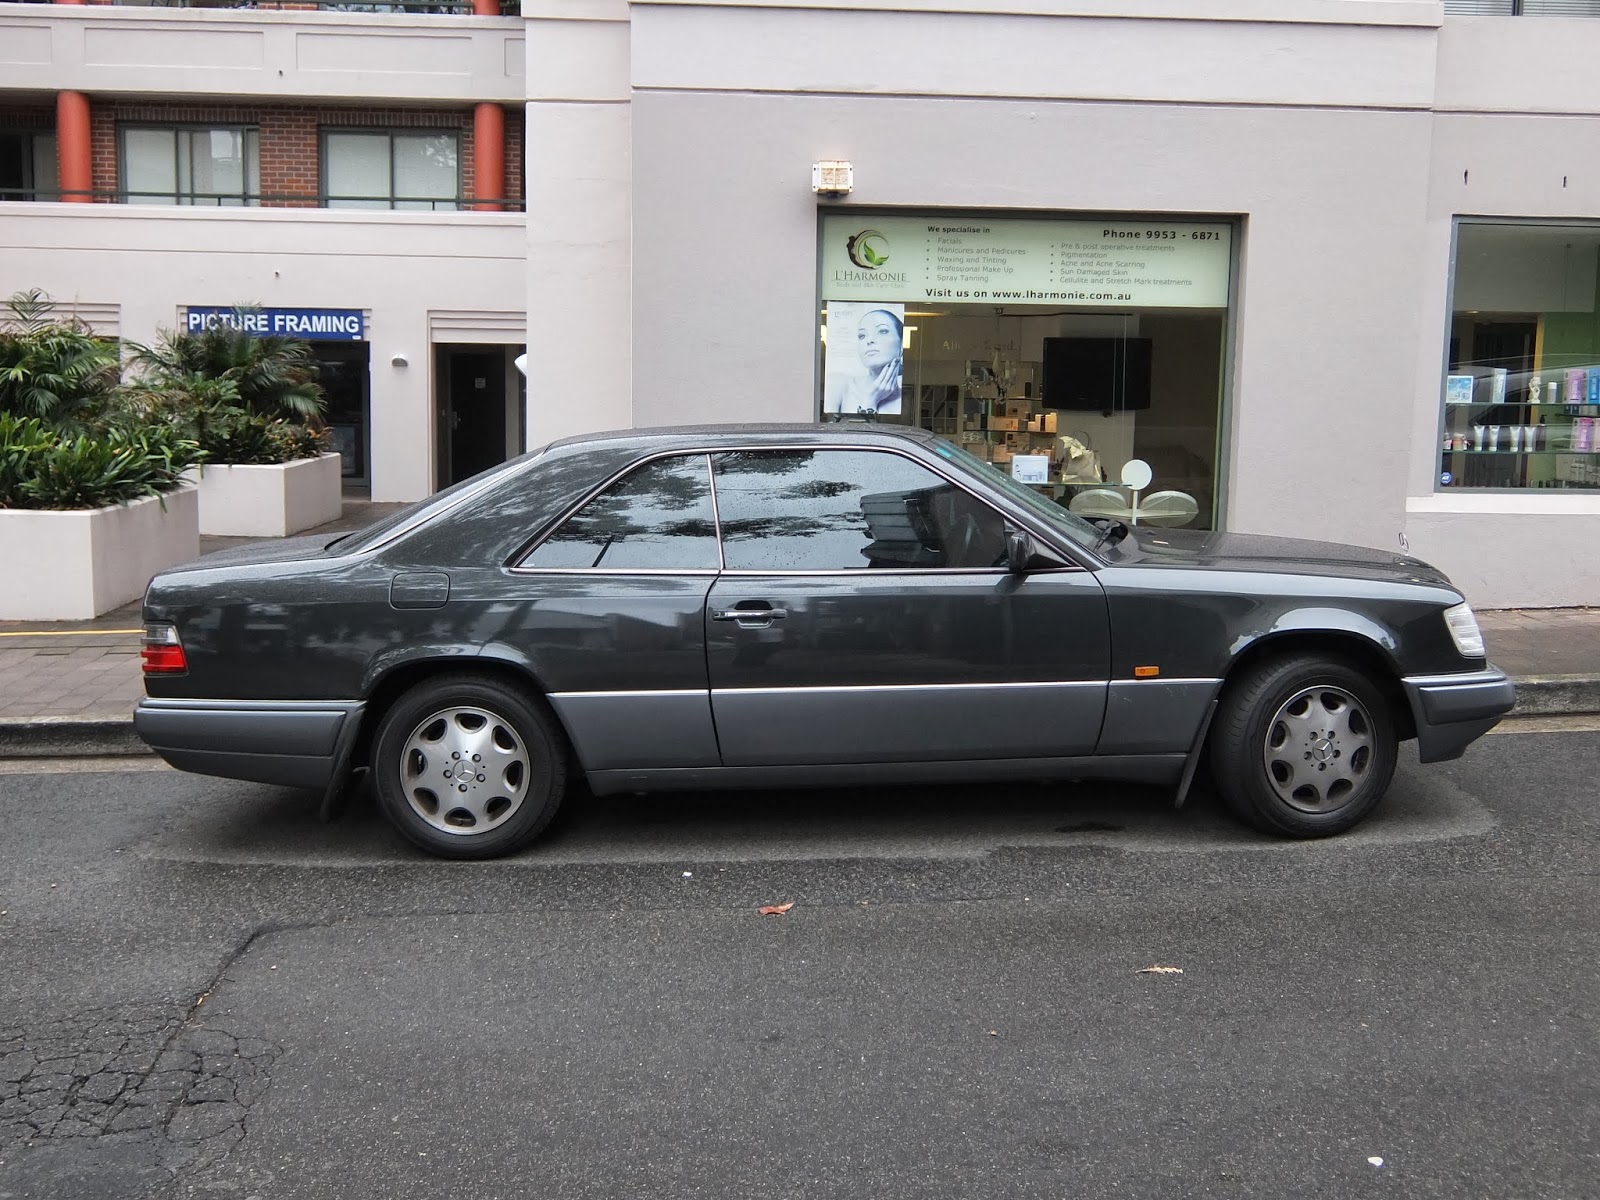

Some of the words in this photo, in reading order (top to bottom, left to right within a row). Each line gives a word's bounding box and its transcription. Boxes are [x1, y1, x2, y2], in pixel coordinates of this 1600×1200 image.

[942, 226, 981, 234] specialise
[1103, 230, 1141, 238] Phone
[1146, 231, 1176, 239] 9953
[1191, 231, 1220, 240] 6871
[1135, 244, 1176, 252] treatments
[1060, 251, 1108, 260] Pigmentation
[937, 256, 964, 264] Waxing
[1115, 261, 1145, 269] Scarring
[1076, 269, 1110, 277] Damaged
[937, 275, 958, 283] Spray
[960, 275, 989, 283] Tanning
[1153, 278, 1192, 286] treatments
[925, 289, 952, 297] Visit
[992, 290, 1131, 300] www.lharmonie.com.au
[188, 313, 269, 331] PICTURE
[274, 315, 359, 333] FRAMING
